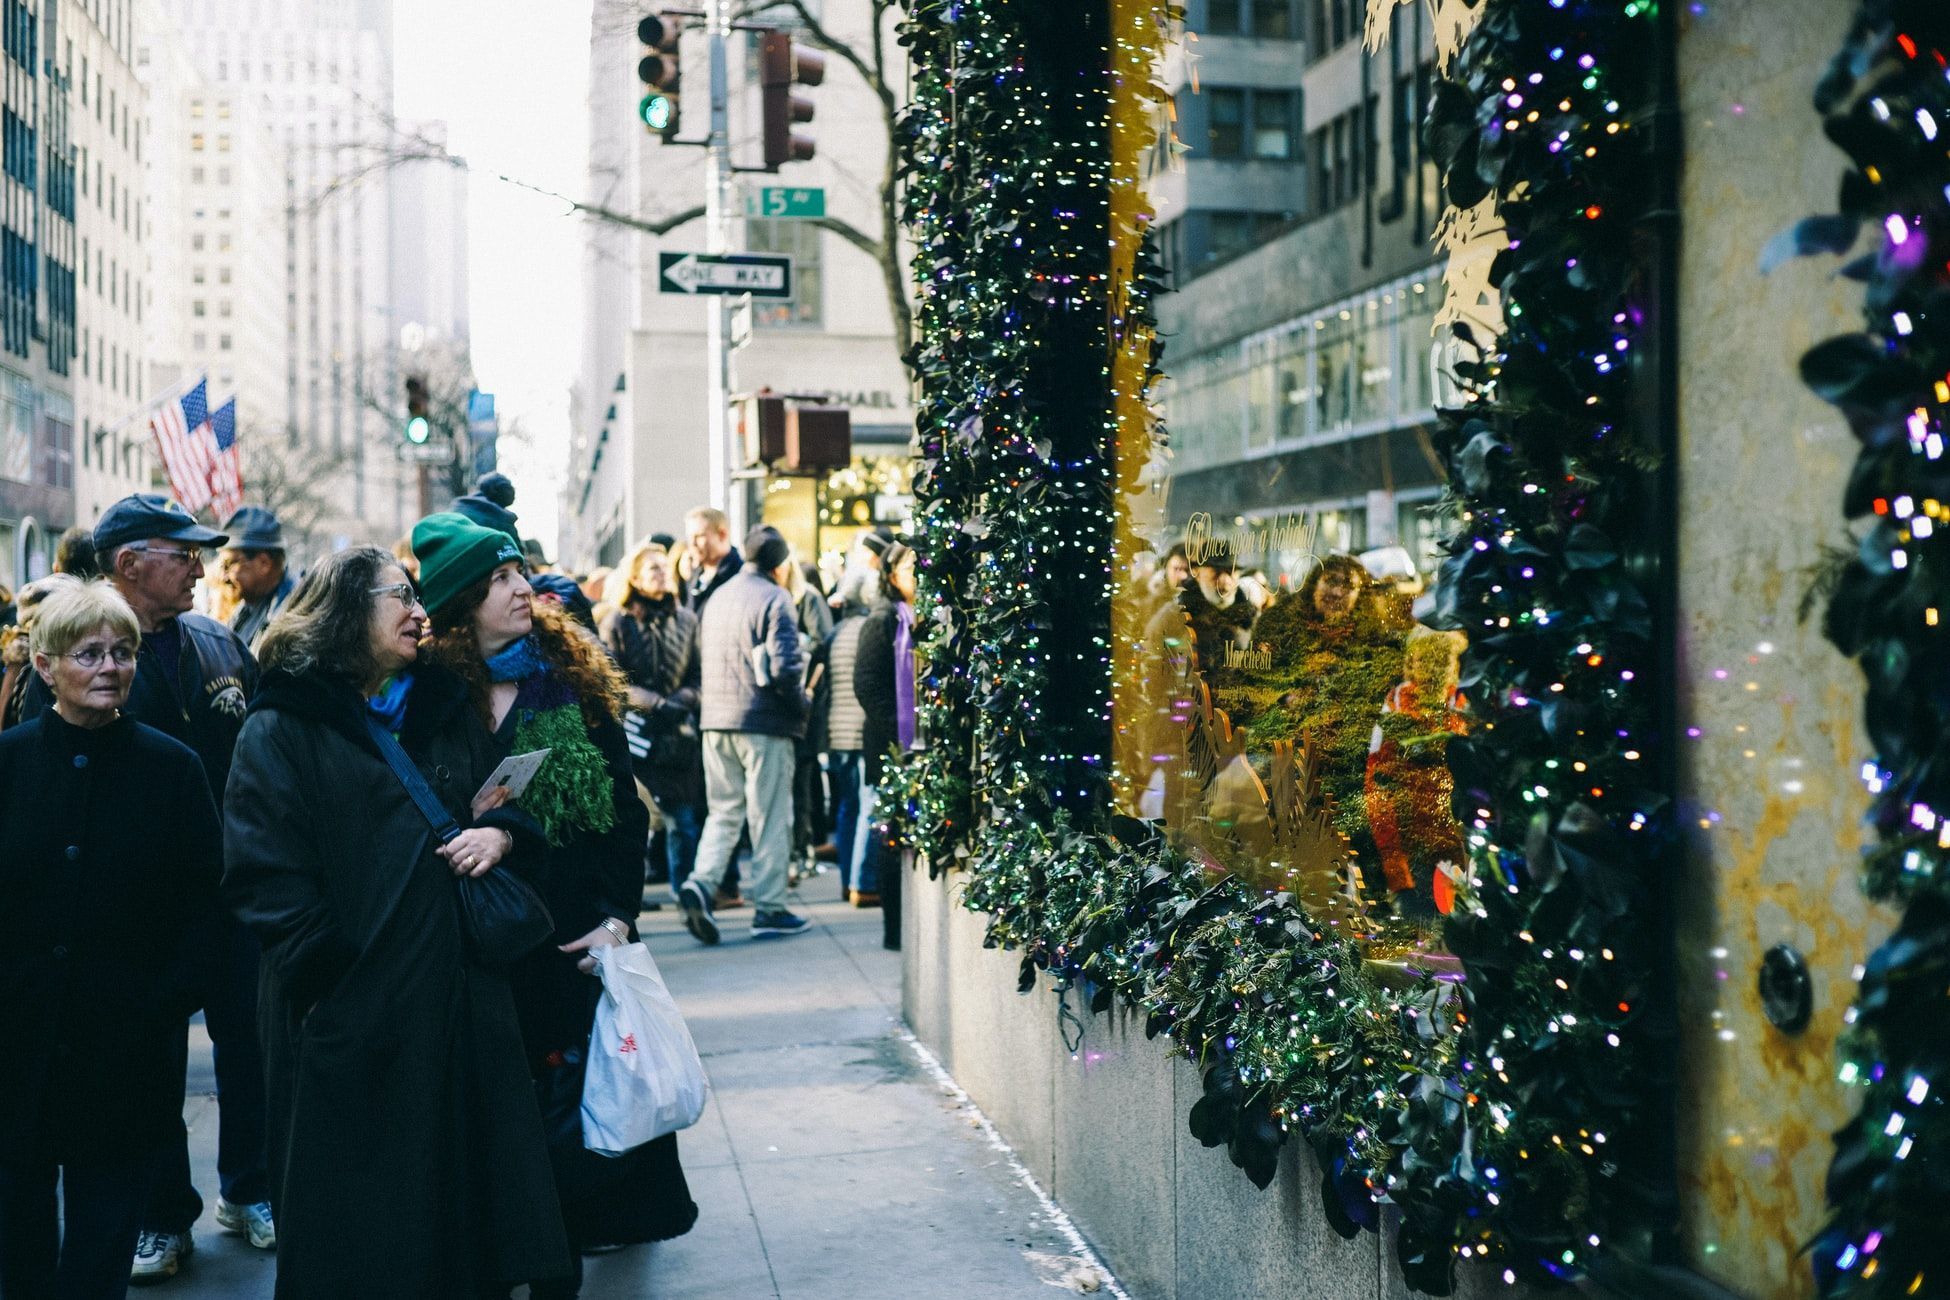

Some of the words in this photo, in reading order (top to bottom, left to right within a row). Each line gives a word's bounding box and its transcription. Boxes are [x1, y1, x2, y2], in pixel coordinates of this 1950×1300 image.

[769, 190, 787, 216] 5
[678, 265, 715, 282] ONE
[735, 268, 774, 283] WAY
[1185, 511, 1228, 577] Once
[1270, 511, 1320, 574] holiday
[1223, 640, 1271, 670] Marchesa
